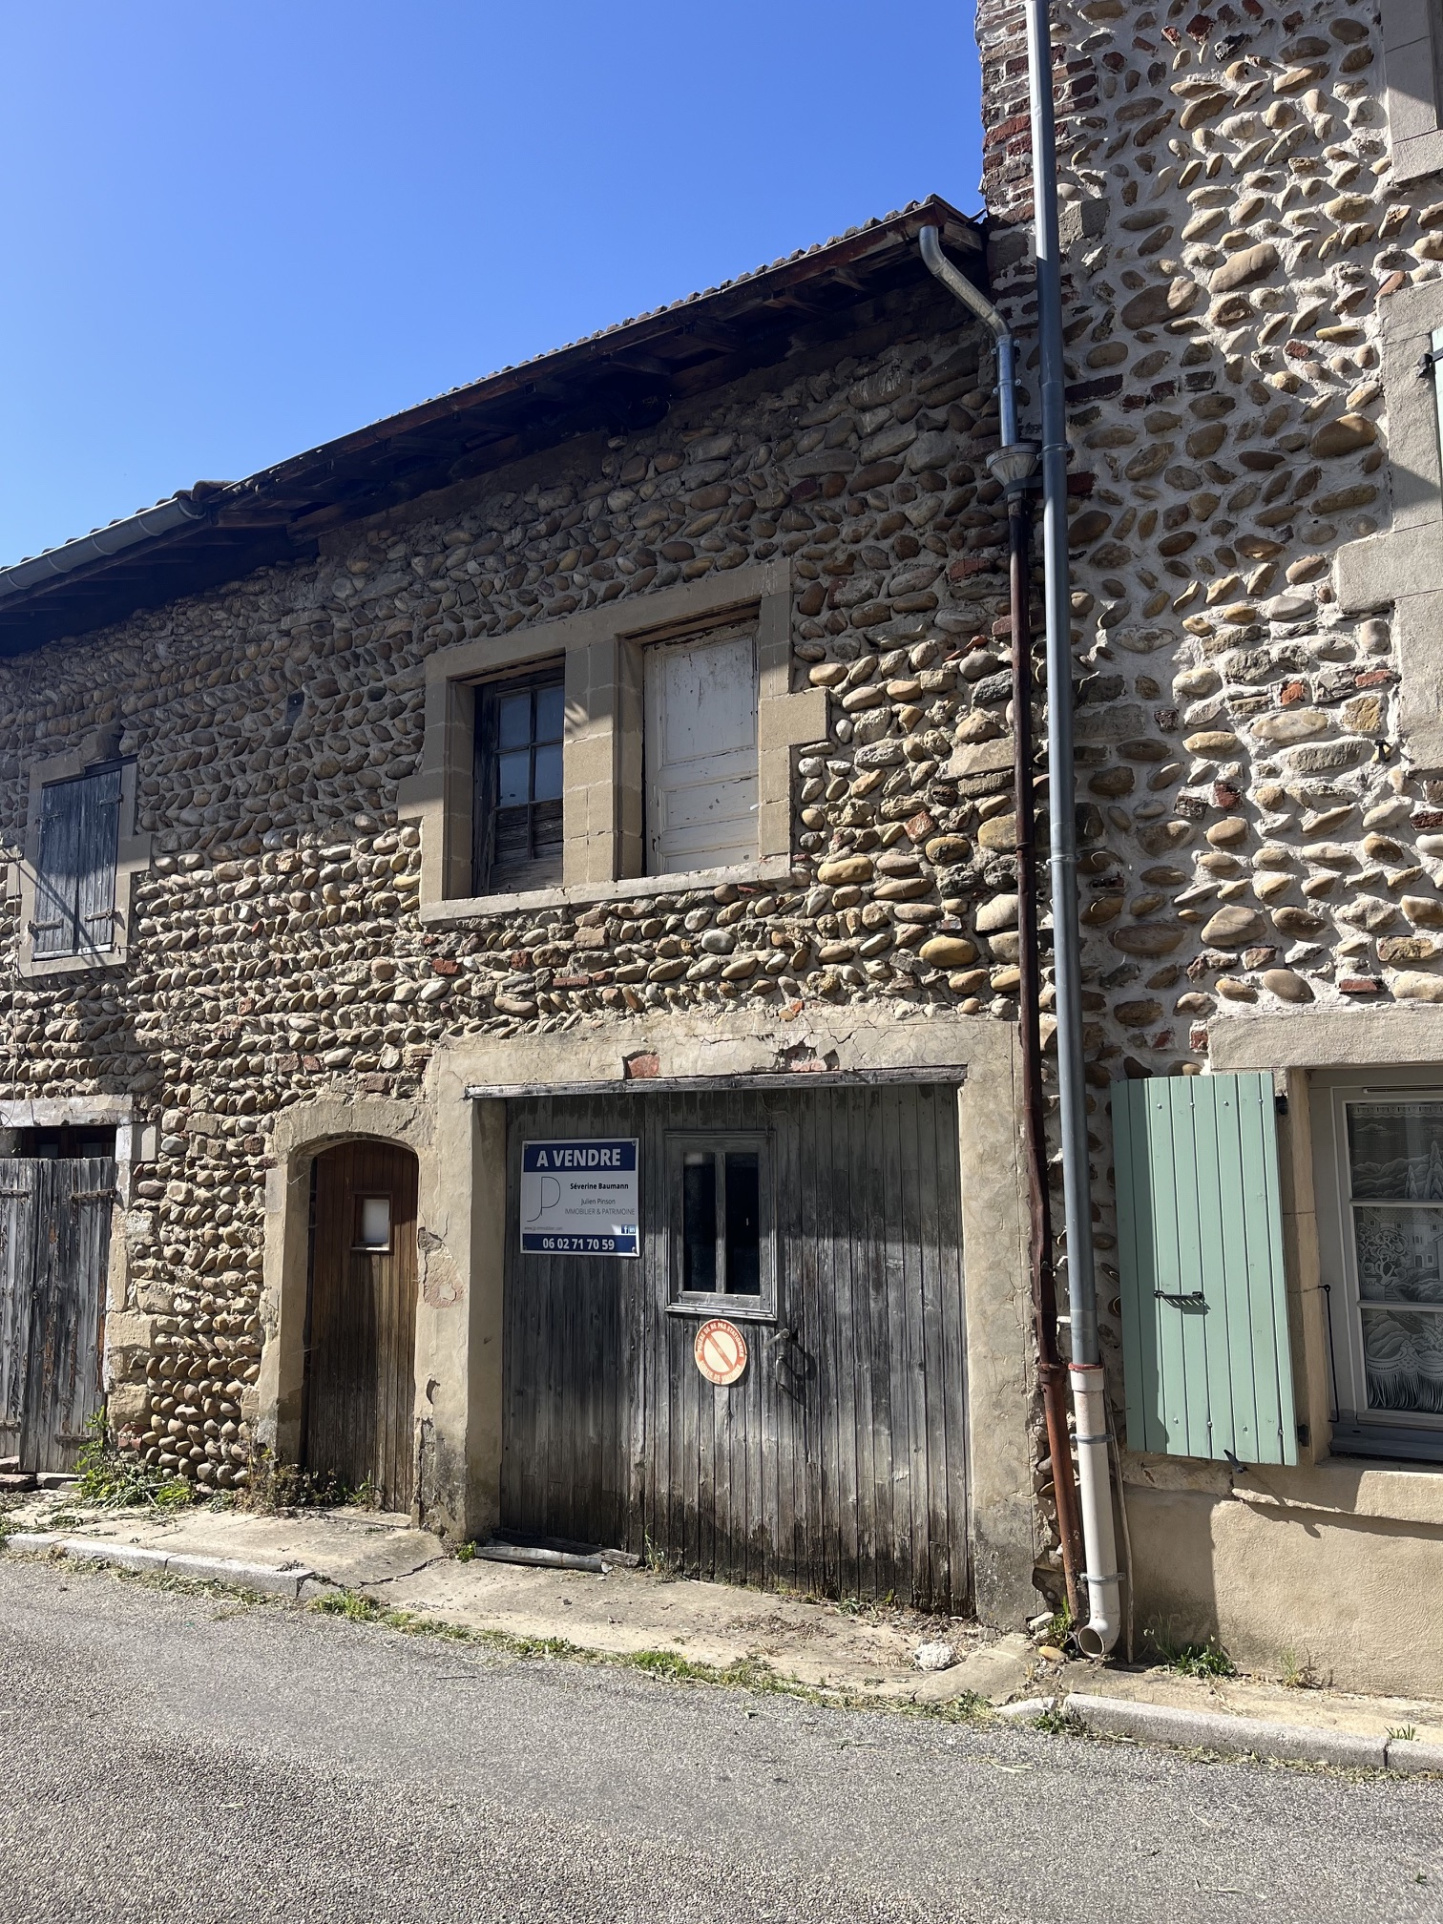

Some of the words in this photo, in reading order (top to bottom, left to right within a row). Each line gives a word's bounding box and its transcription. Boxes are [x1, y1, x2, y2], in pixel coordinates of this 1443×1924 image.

[536, 1151, 548, 1167] A
[553, 1149, 621, 1167] VENDRE
[581, 1198, 596, 1206] Julien
[543, 1238, 555, 1249] 06
[557, 1238, 569, 1249] 02
[572, 1238, 584, 1249] 71
[587, 1238, 599, 1250] 70
[601, 1239, 615, 1250] 59
